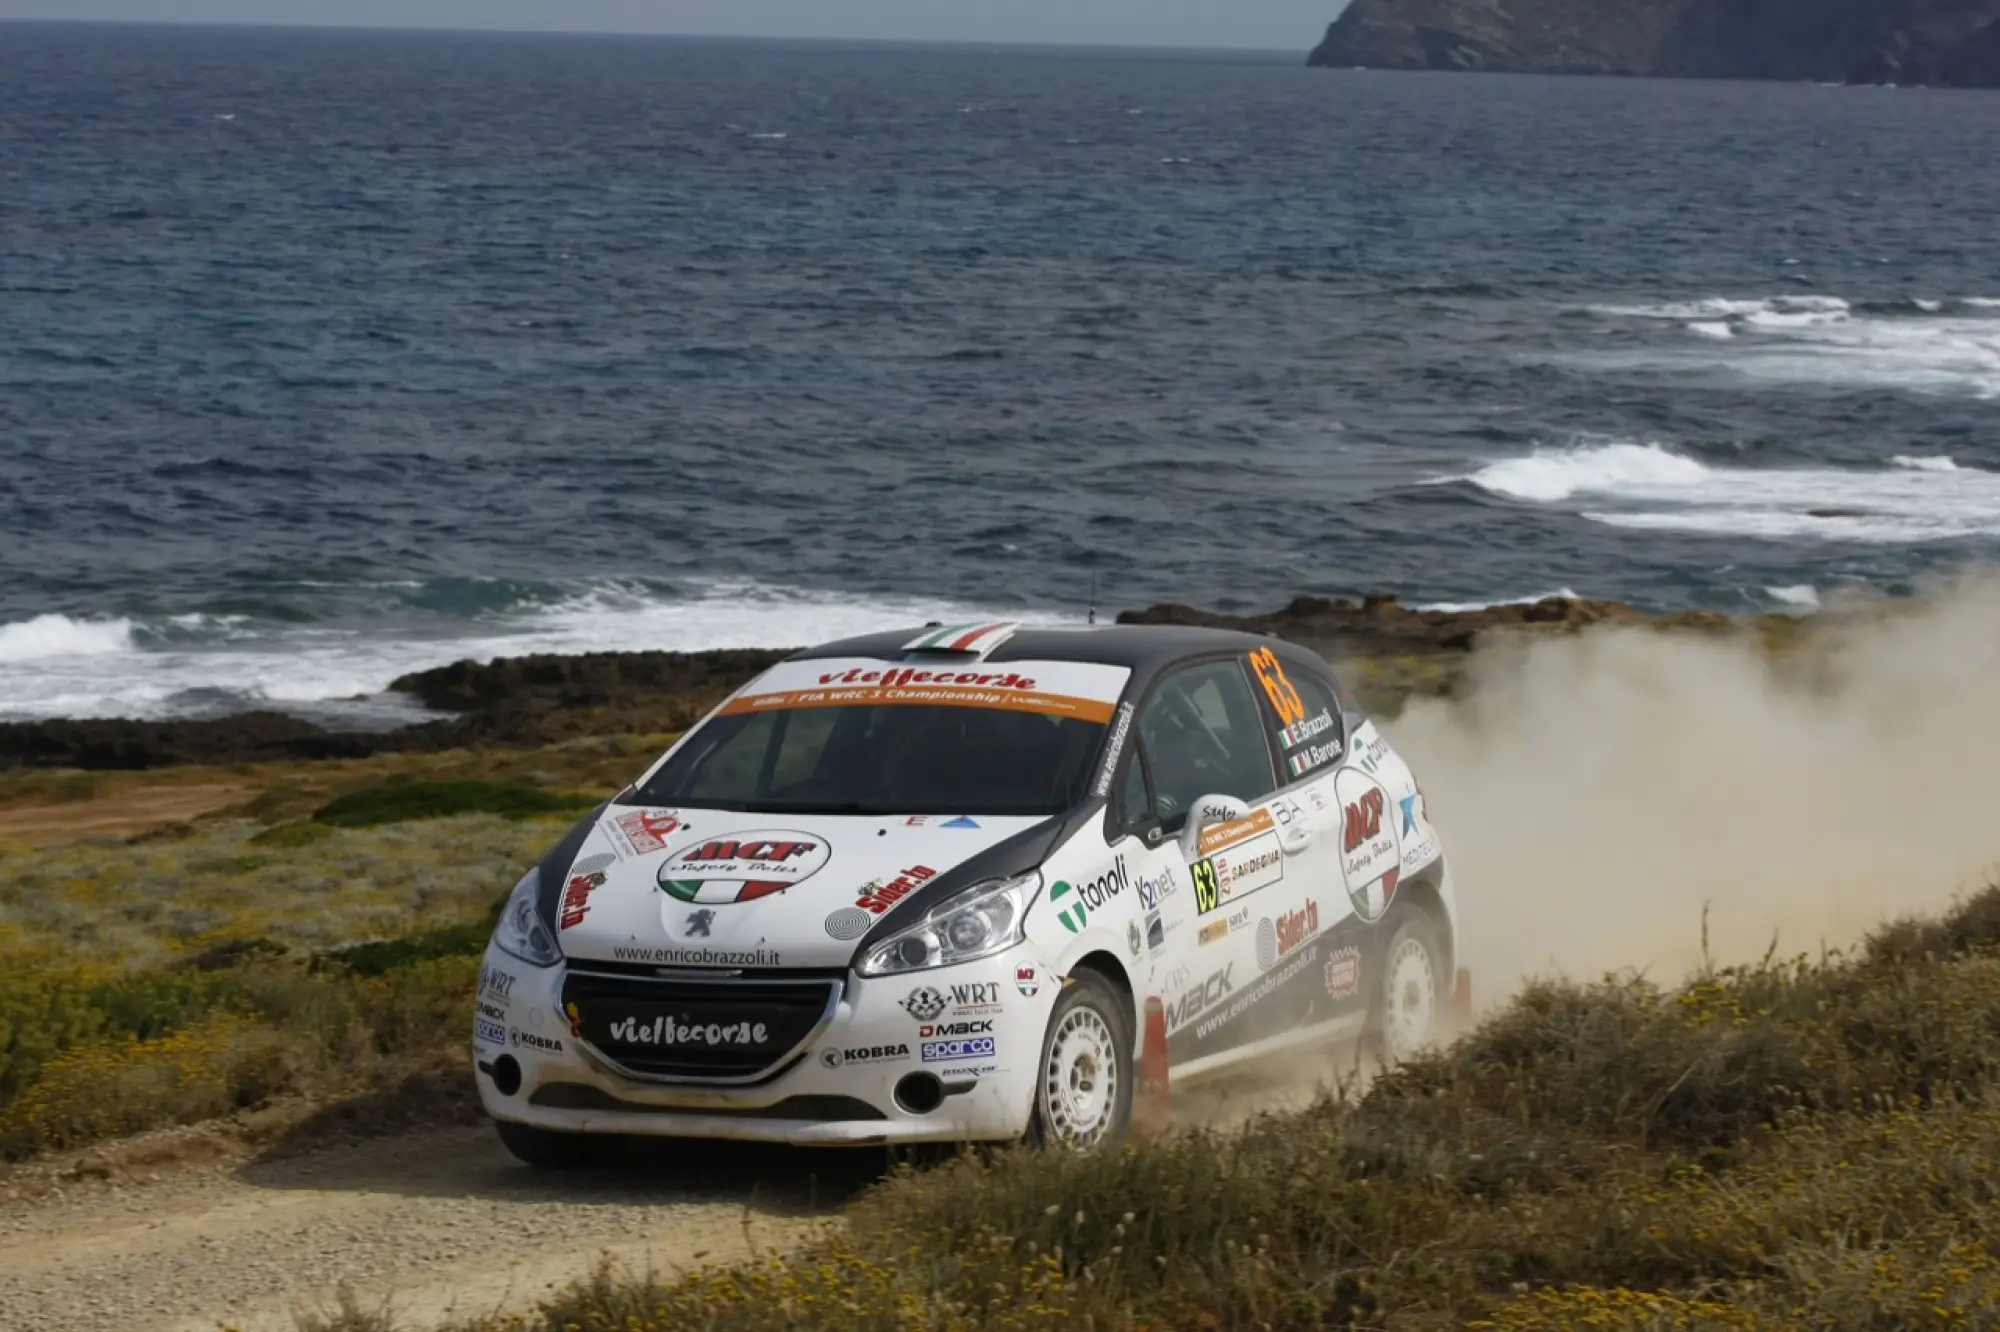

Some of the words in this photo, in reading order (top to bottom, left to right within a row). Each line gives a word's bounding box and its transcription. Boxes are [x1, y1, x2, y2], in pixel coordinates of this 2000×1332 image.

[886, 689, 1001, 703] Championship
[1248, 645, 1305, 726] 63
[681, 840, 818, 862] MCF
[1076, 853, 1129, 912] tonoli
[1193, 859, 1217, 913] 63
[613, 946, 781, 966] www.enricobrazzoli.it
[950, 982, 1001, 1005] WRT
[521, 1031, 564, 1052] KOBRA
[610, 1016, 769, 1046] vieffecorse
[844, 1043, 910, 1060] KOBRA
[923, 1038, 993, 1059] sparco
